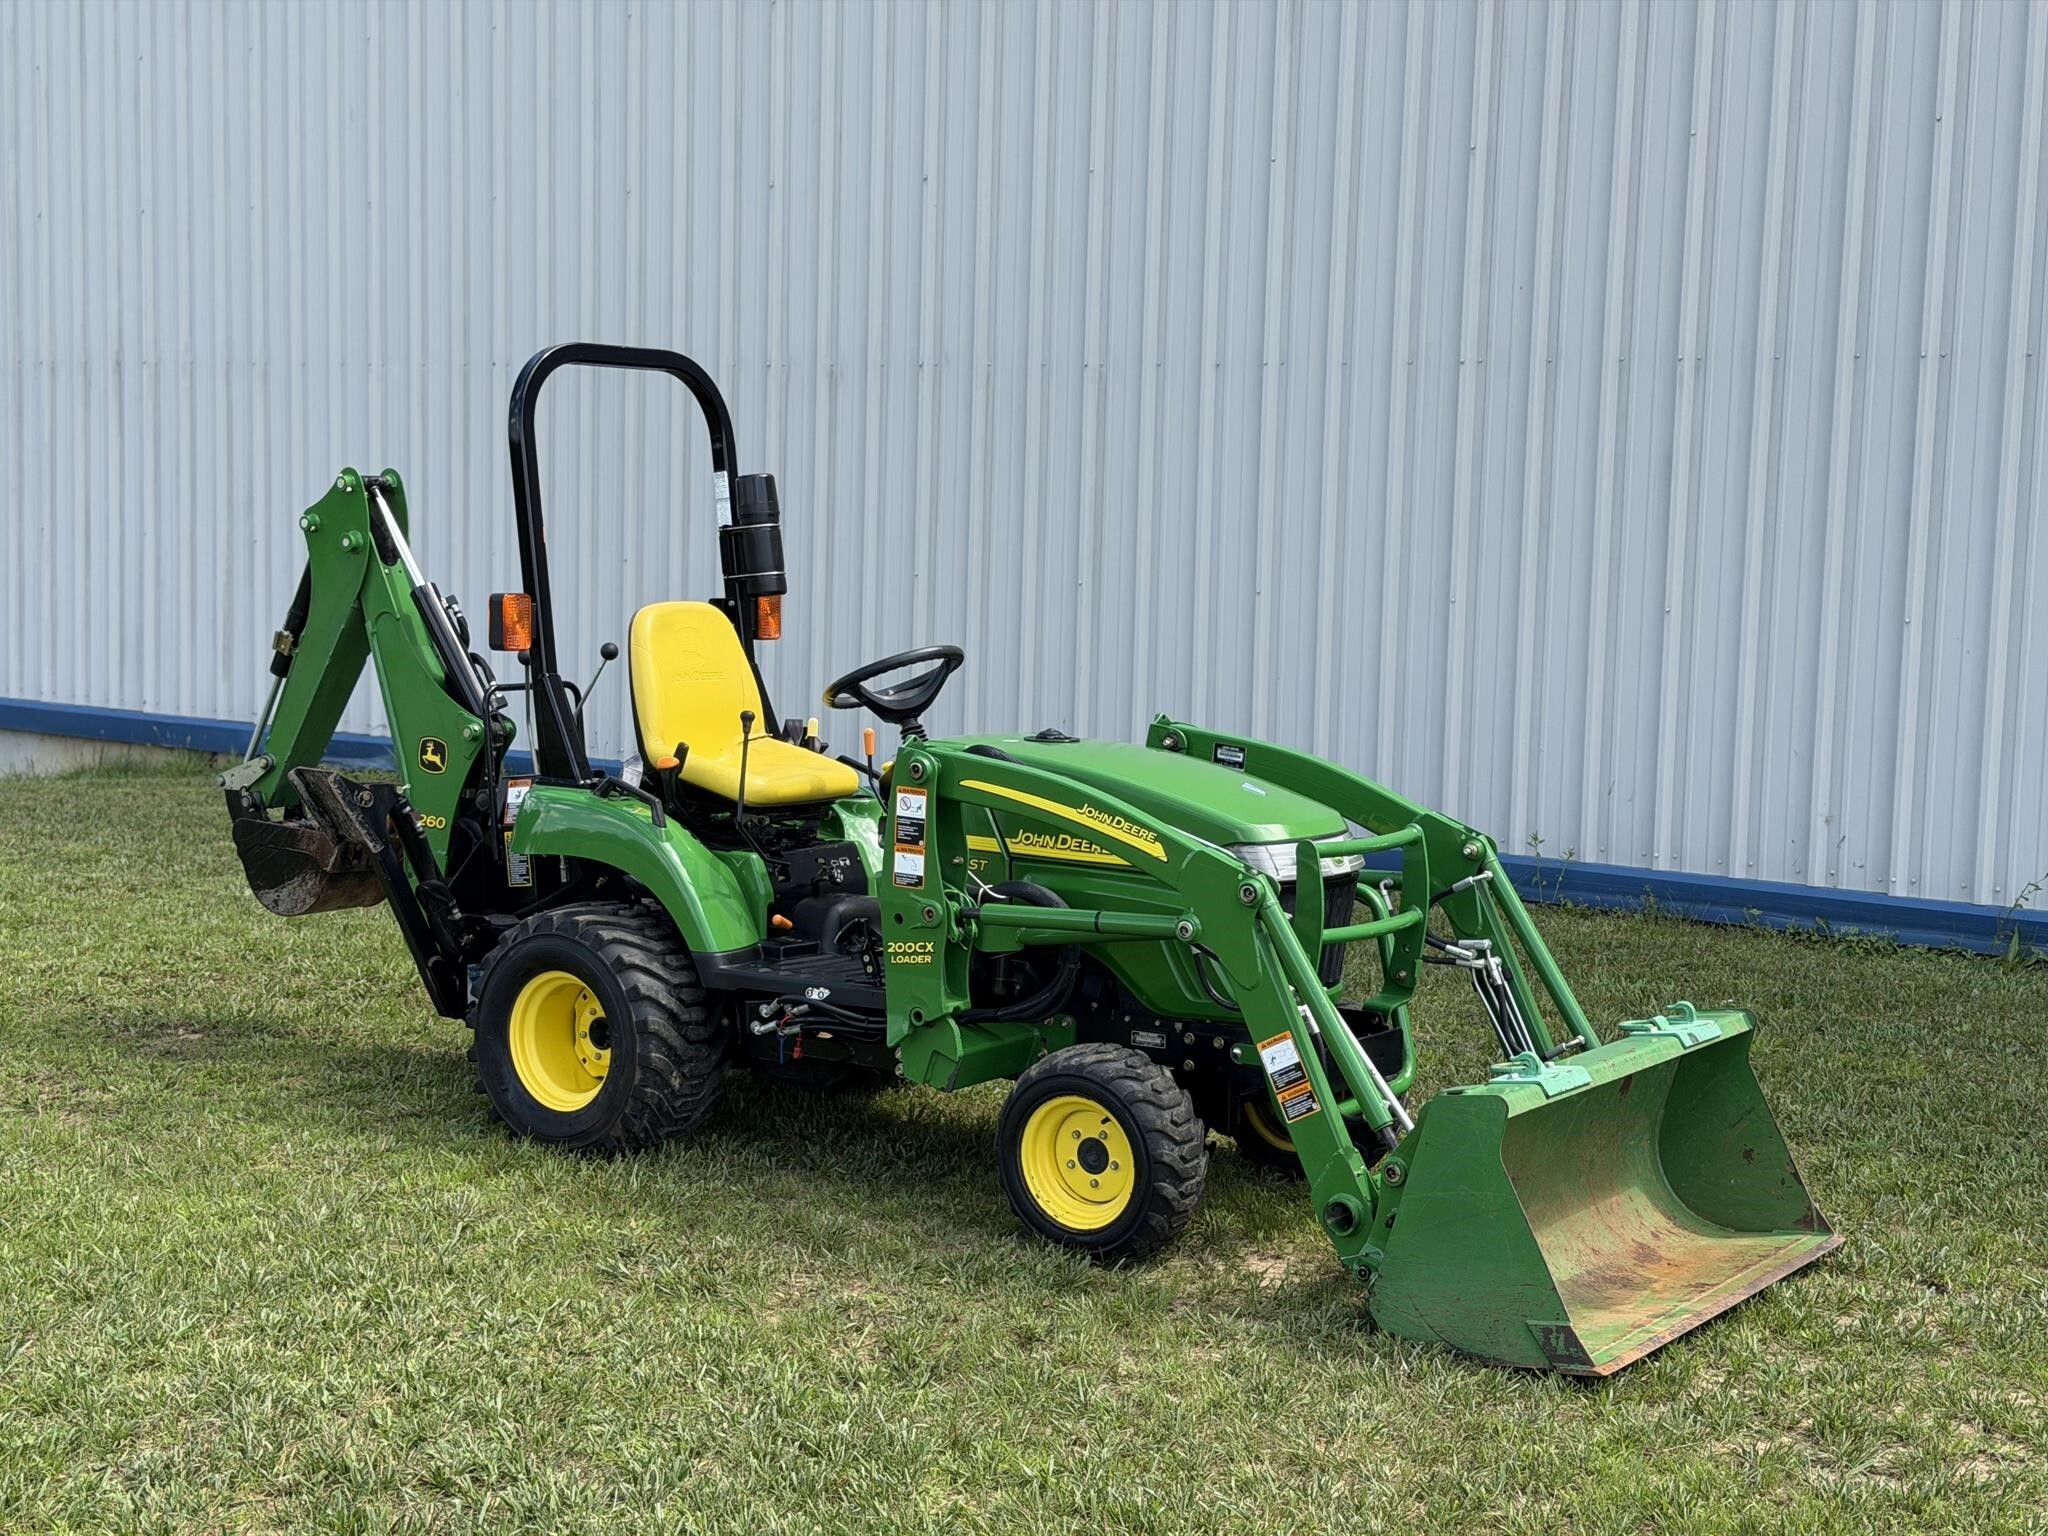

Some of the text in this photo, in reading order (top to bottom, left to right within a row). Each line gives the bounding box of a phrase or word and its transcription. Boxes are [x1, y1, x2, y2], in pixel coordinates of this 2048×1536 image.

[418, 814, 446, 829] 260
[1076, 803, 1157, 843] JOHN DEERE
[1011, 829, 1112, 855] JOHN DEER
[887, 942, 934, 953] 200CX
[891, 955, 932, 964] LOADER
